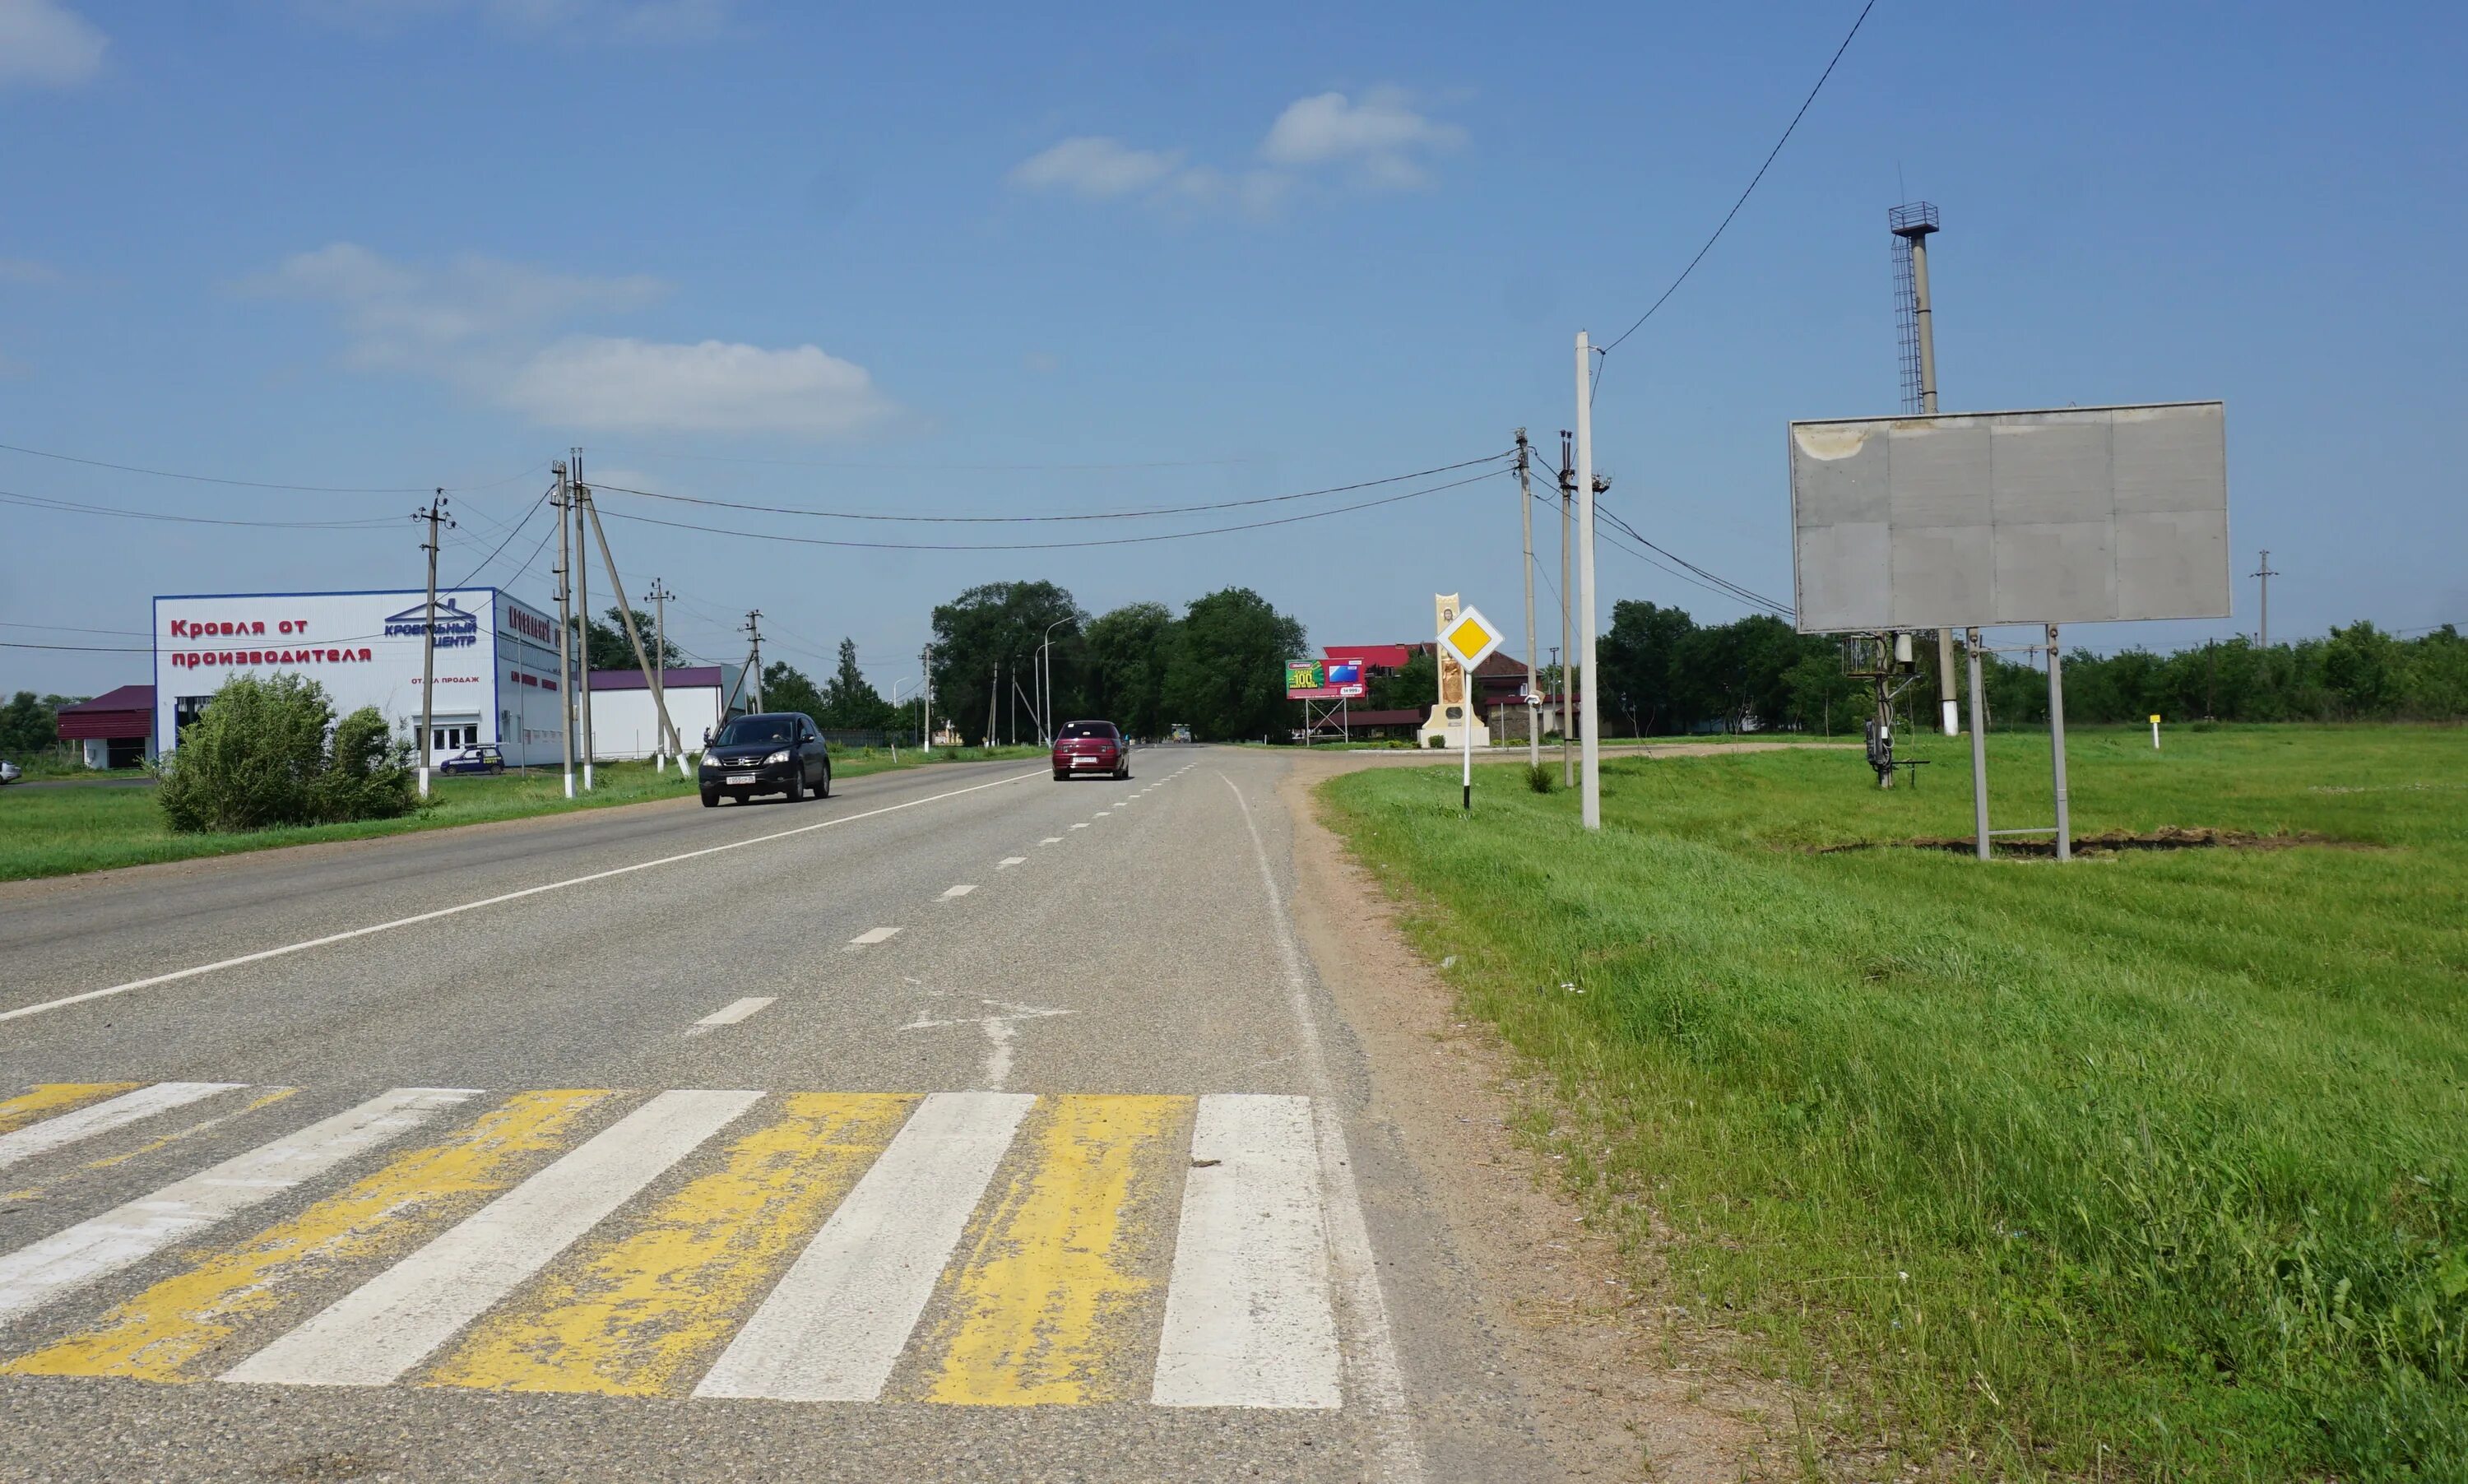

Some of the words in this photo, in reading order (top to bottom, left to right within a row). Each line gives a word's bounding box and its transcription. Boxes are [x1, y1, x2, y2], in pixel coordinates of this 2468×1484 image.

[171, 619, 265, 639] Кровля
[279, 620, 308, 633] от
[385, 620, 477, 635] КРОВЕЬНЫЙ
[172, 648, 372, 669] производителя
